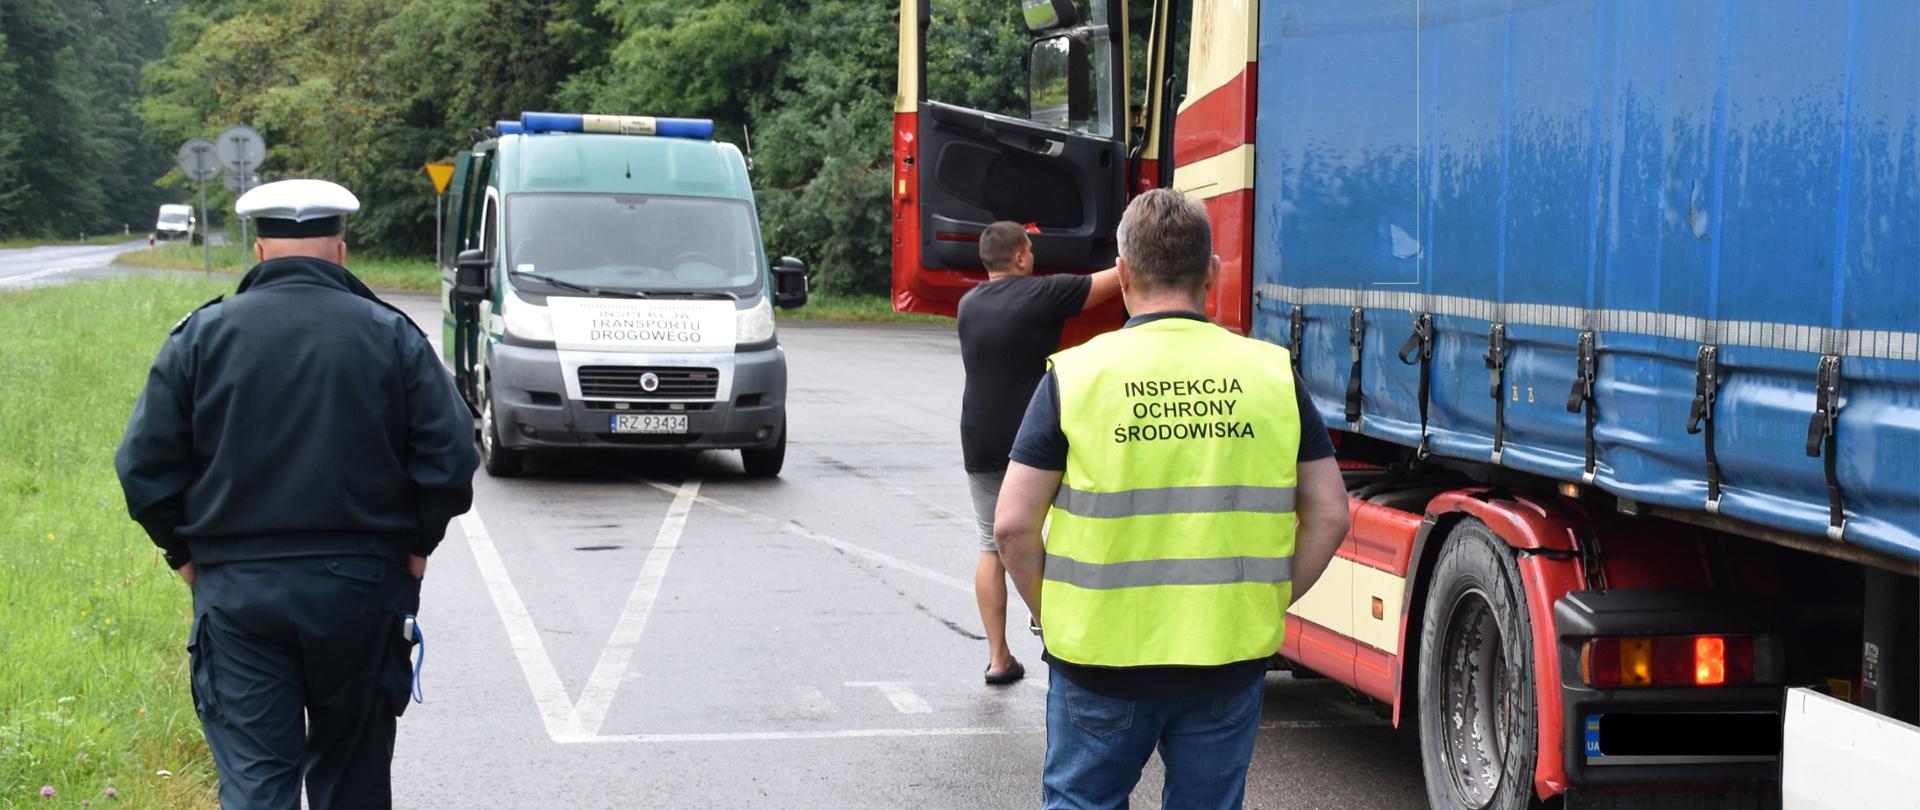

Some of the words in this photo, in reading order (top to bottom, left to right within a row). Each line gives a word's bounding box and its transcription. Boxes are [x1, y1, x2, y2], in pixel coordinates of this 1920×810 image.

[592, 319, 701, 331] TRANSPORTU
[590, 329, 701, 343] DROGOWEGO
[1124, 378, 1243, 398] INSPEKCJA
[1133, 399, 1237, 419] OCHRONY
[619, 416, 639, 429] RZ
[644, 416, 686, 429] 93434
[1114, 422, 1255, 443] ŚRODOWISKA
[1587, 741, 1600, 751] UA
